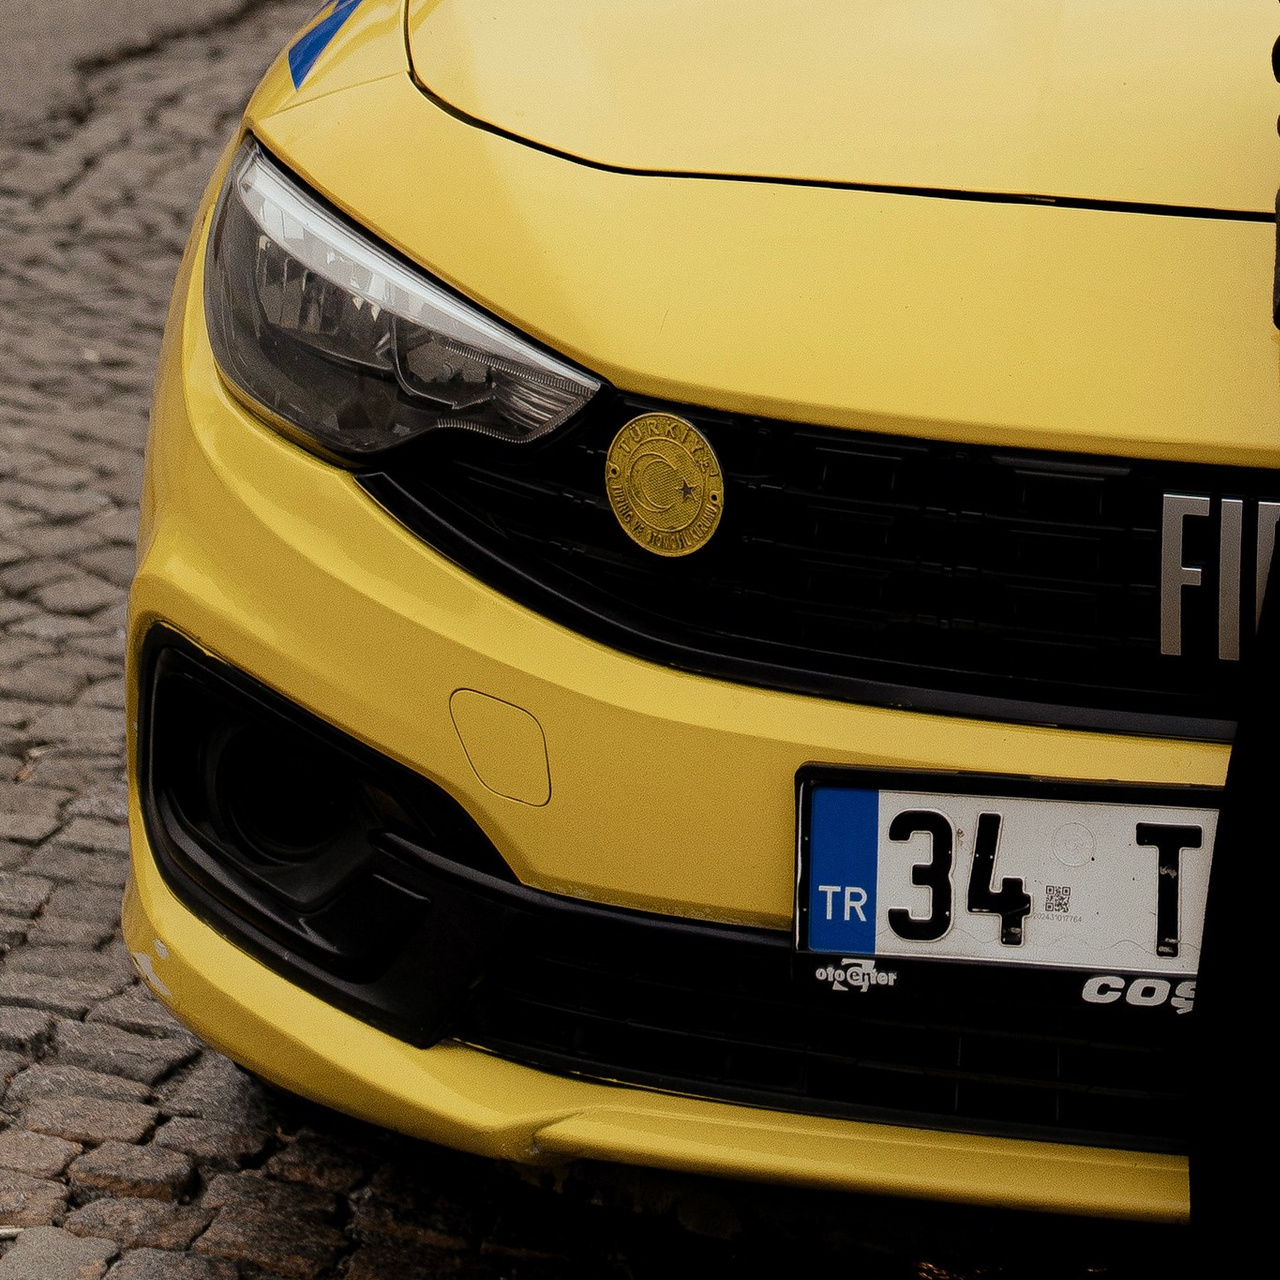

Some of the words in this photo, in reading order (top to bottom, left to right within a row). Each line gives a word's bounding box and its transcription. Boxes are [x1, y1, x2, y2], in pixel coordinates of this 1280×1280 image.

[818, 885, 868, 923] TR
[888, 808, 1032, 948] 34
[1135, 822, 1202, 958] T
